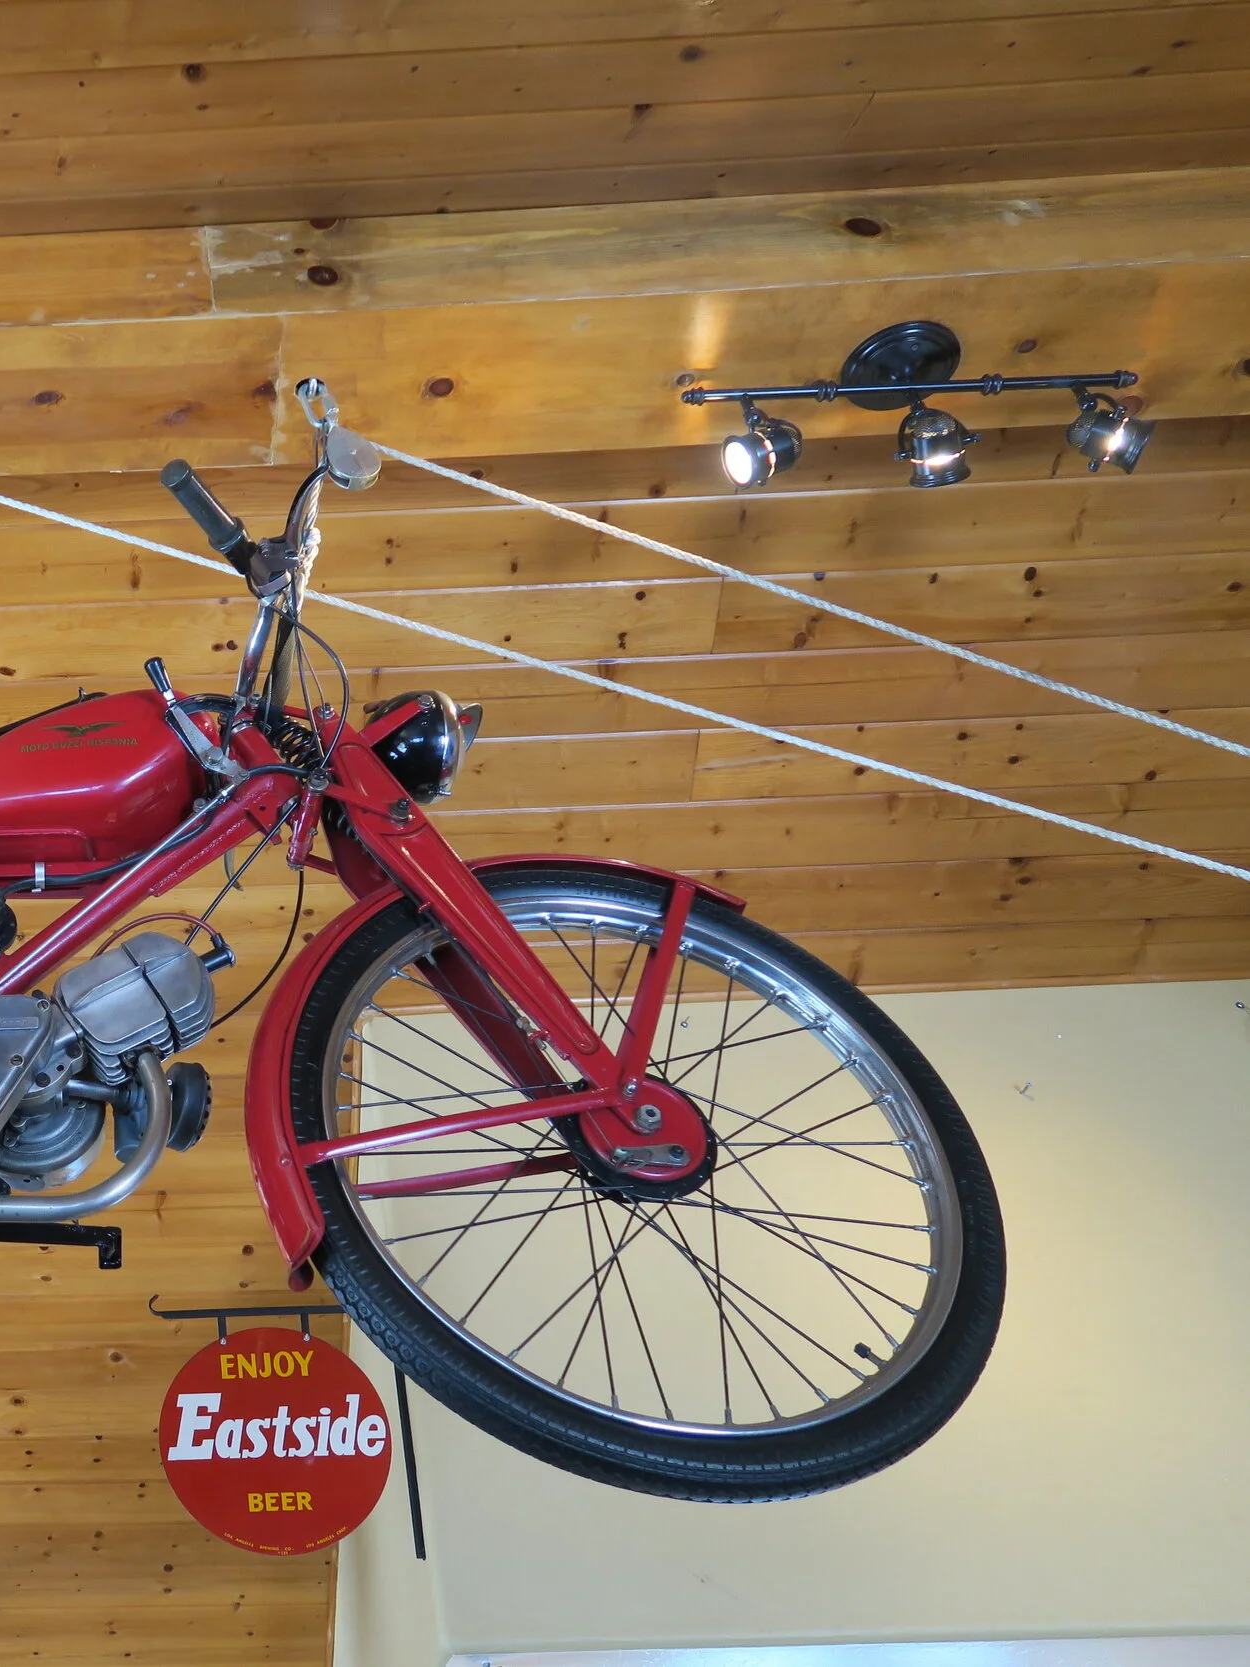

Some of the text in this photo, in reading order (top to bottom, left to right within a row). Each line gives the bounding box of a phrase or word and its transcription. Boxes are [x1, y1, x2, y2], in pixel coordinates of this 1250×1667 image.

[20, 737, 138, 753] MOTO GUZZI HISPANIA
[219, 1350, 314, 1380] ENJOY
[167, 1392, 387, 1461] Eastside
[247, 1491, 313, 1513] BEER
[224, 1532, 233, 1540] LOS
[236, 1537, 254, 1548] ANGELES
[317, 1534, 335, 1545] ANGELES
